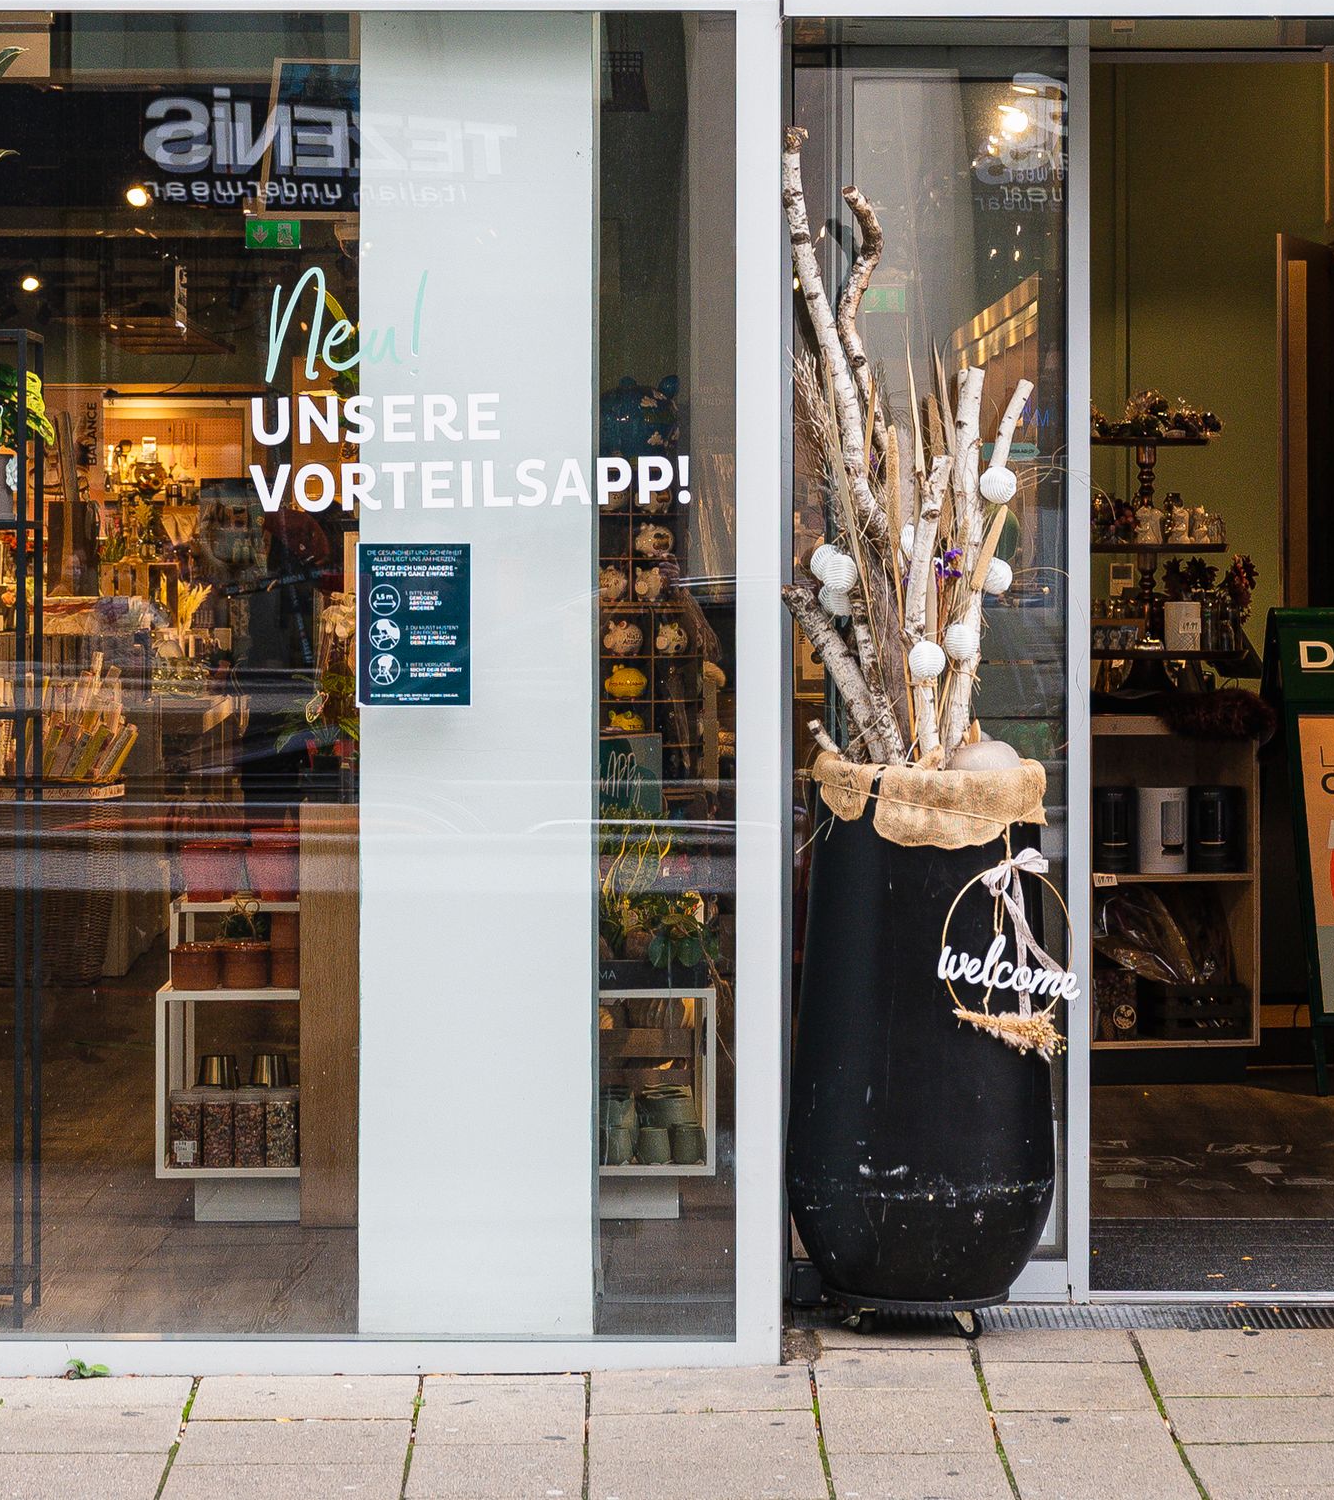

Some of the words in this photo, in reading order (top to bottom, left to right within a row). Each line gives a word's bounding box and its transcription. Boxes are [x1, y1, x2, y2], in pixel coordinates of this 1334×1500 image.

[265, 266, 429, 383] Neu!
[87, 403, 98, 466] BALANCE
[251, 392, 501, 446] UNSERE
[249, 454, 692, 513] VORTEILSAPP!
[937, 933, 1081, 1001] welcome
